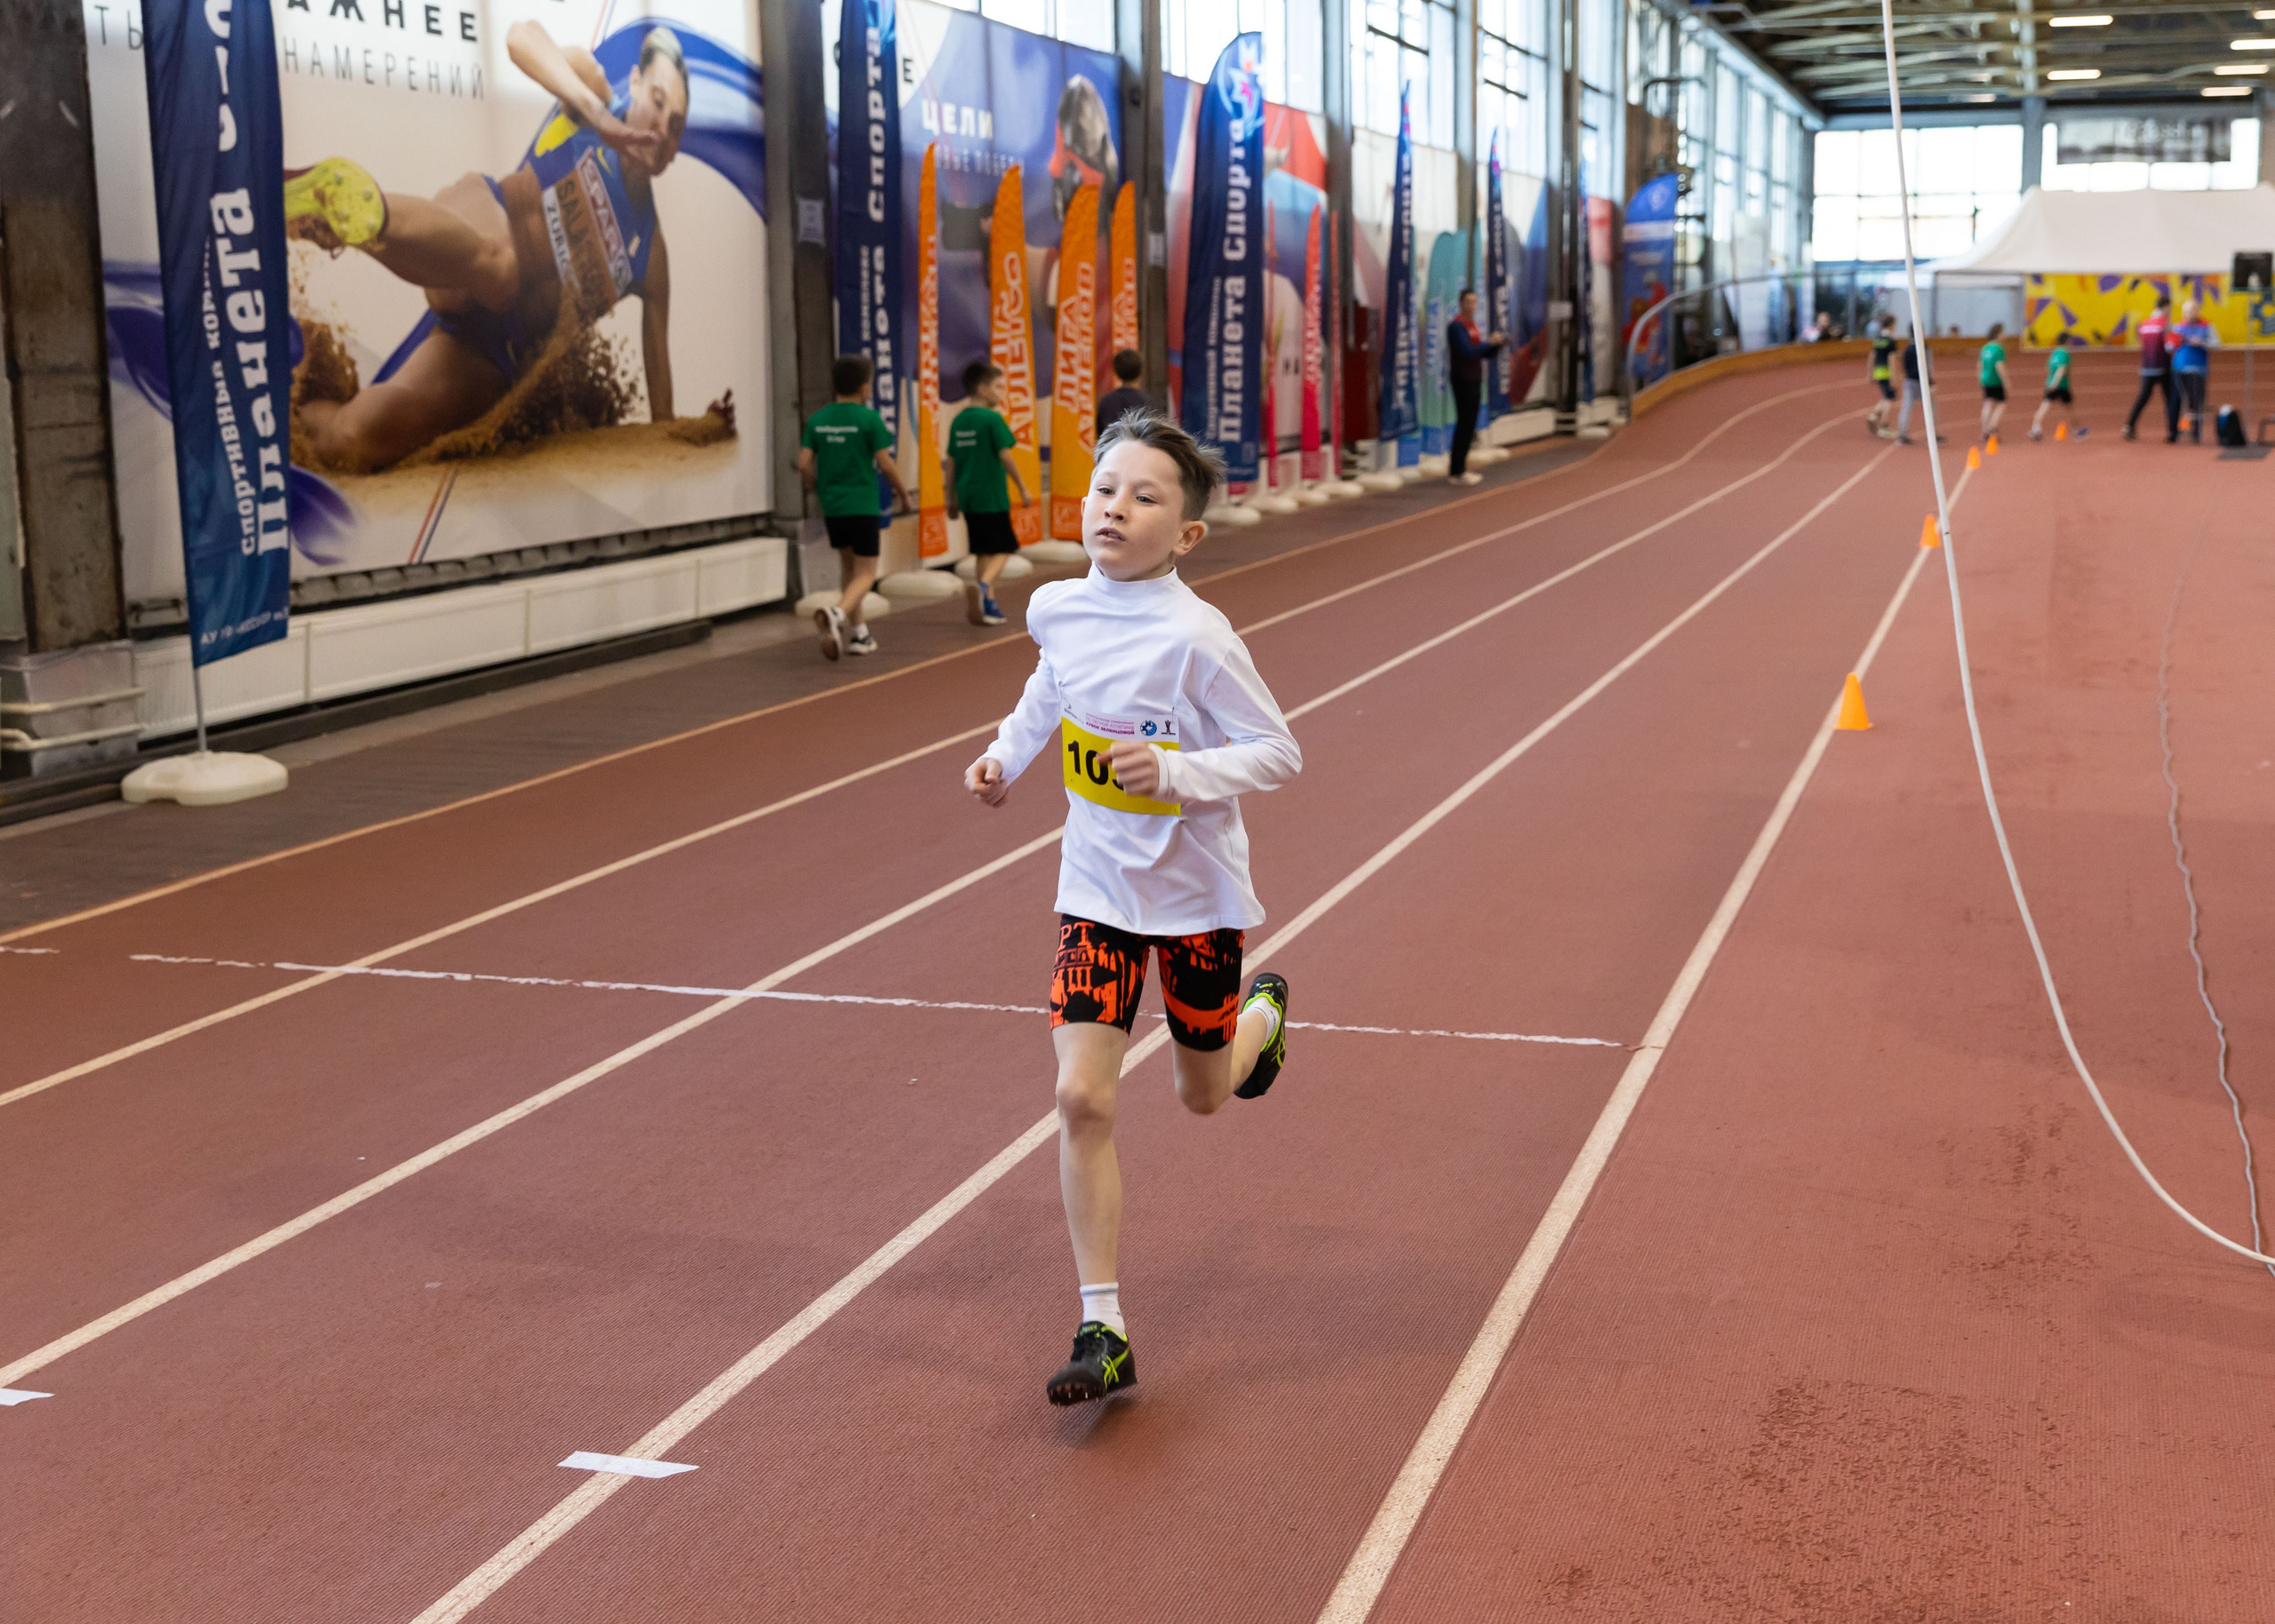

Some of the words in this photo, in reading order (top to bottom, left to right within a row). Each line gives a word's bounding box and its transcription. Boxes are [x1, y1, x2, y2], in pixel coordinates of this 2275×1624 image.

[283, 36, 484, 100] НАМЕРЕНИЙ
[921, 98, 994, 140] ЦЕЛИ
[1223, 117, 1251, 261] Спорта
[210, 187, 290, 556] Планета
[1217, 275, 1247, 443] Планета
[1067, 739, 1125, 792] 10
